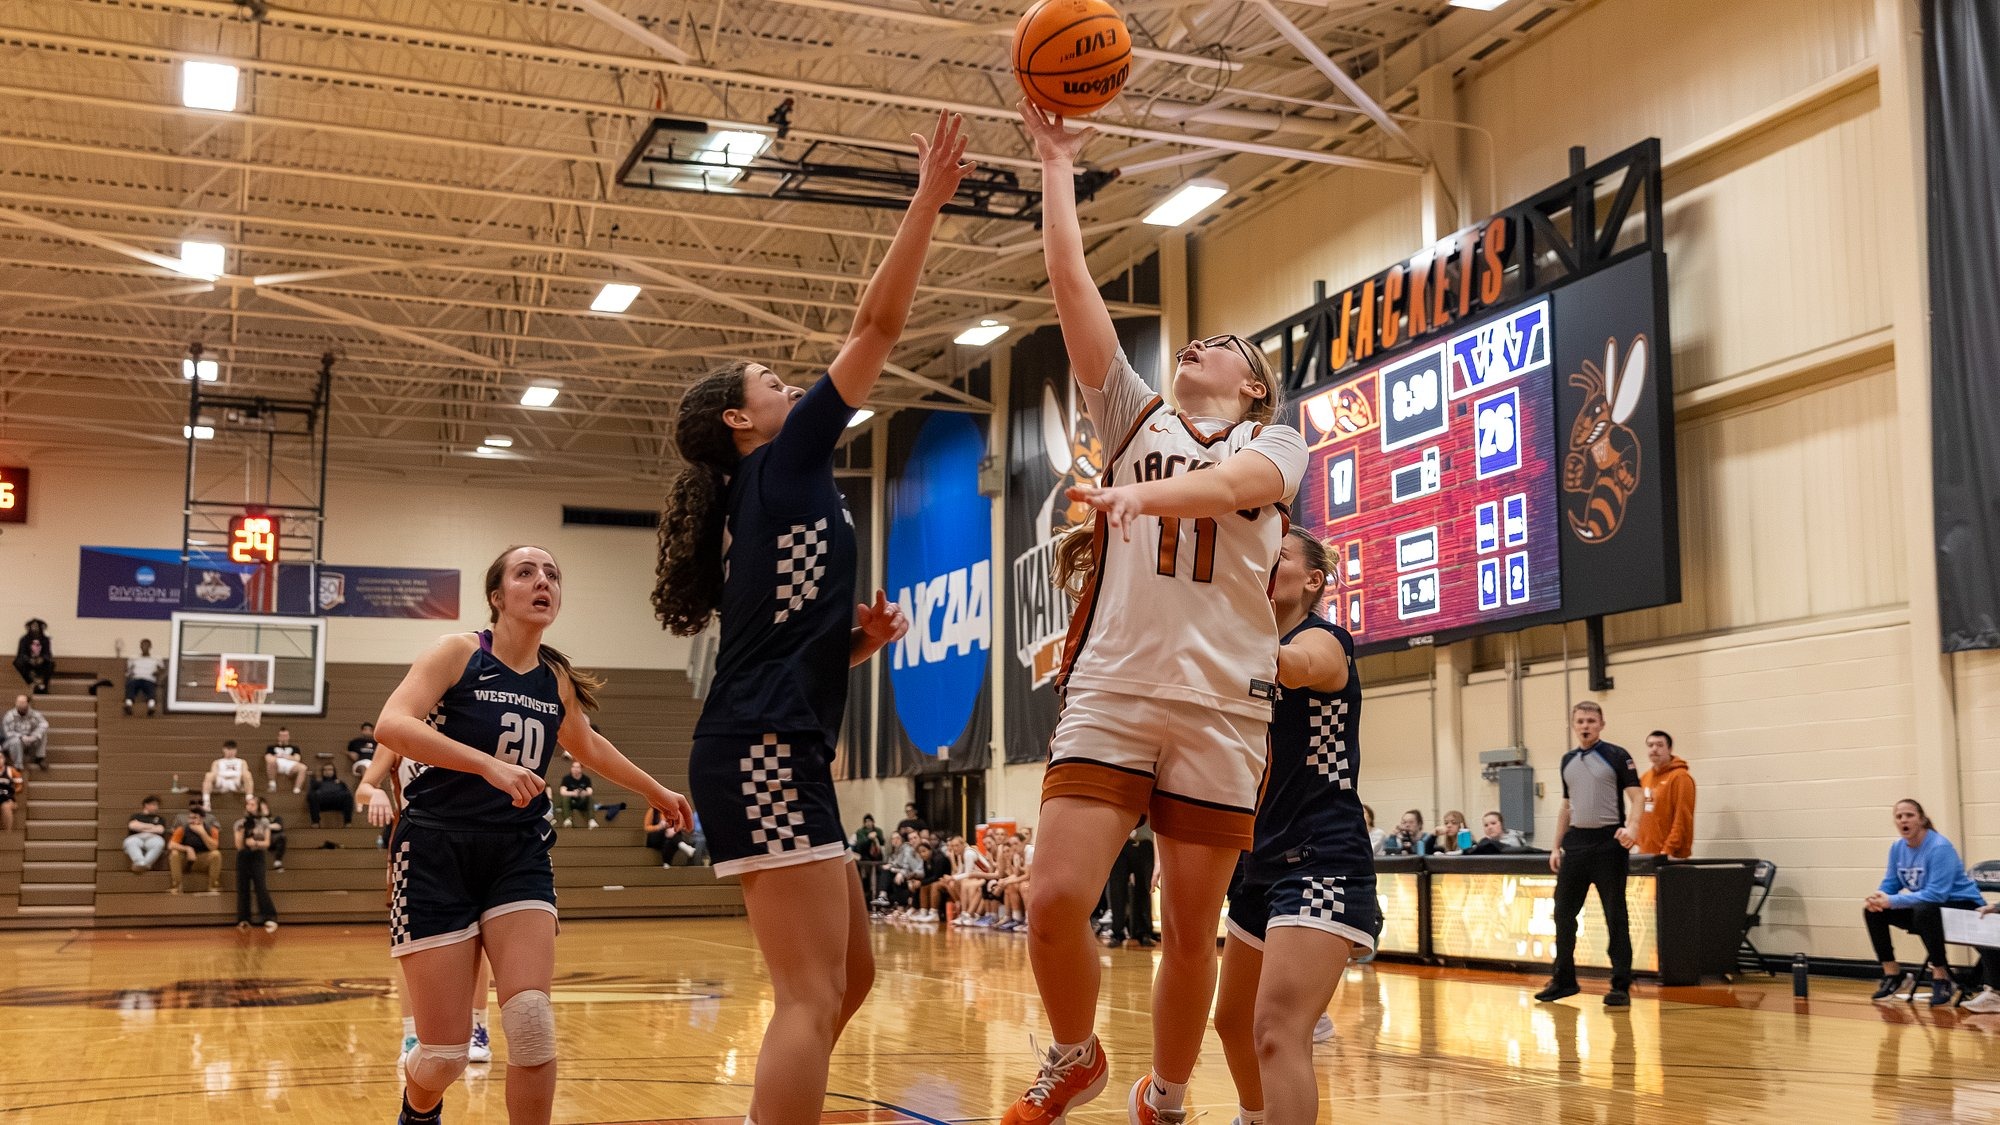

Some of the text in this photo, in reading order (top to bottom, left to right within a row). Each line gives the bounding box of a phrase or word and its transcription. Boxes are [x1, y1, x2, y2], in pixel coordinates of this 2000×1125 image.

[1075, 28, 1116, 57] EVO
[1063, 63, 1129, 95] Wilson
[1331, 217, 1506, 370] JACKETS
[1479, 402, 1515, 459] 26
[1330, 458, 1353, 506] 17
[232, 529, 275, 562] 24
[1156, 516, 1218, 583] 11
[108, 585, 167, 599] DIVISION
[893, 558, 991, 671] NCAA
[494, 712, 545, 770] 20
